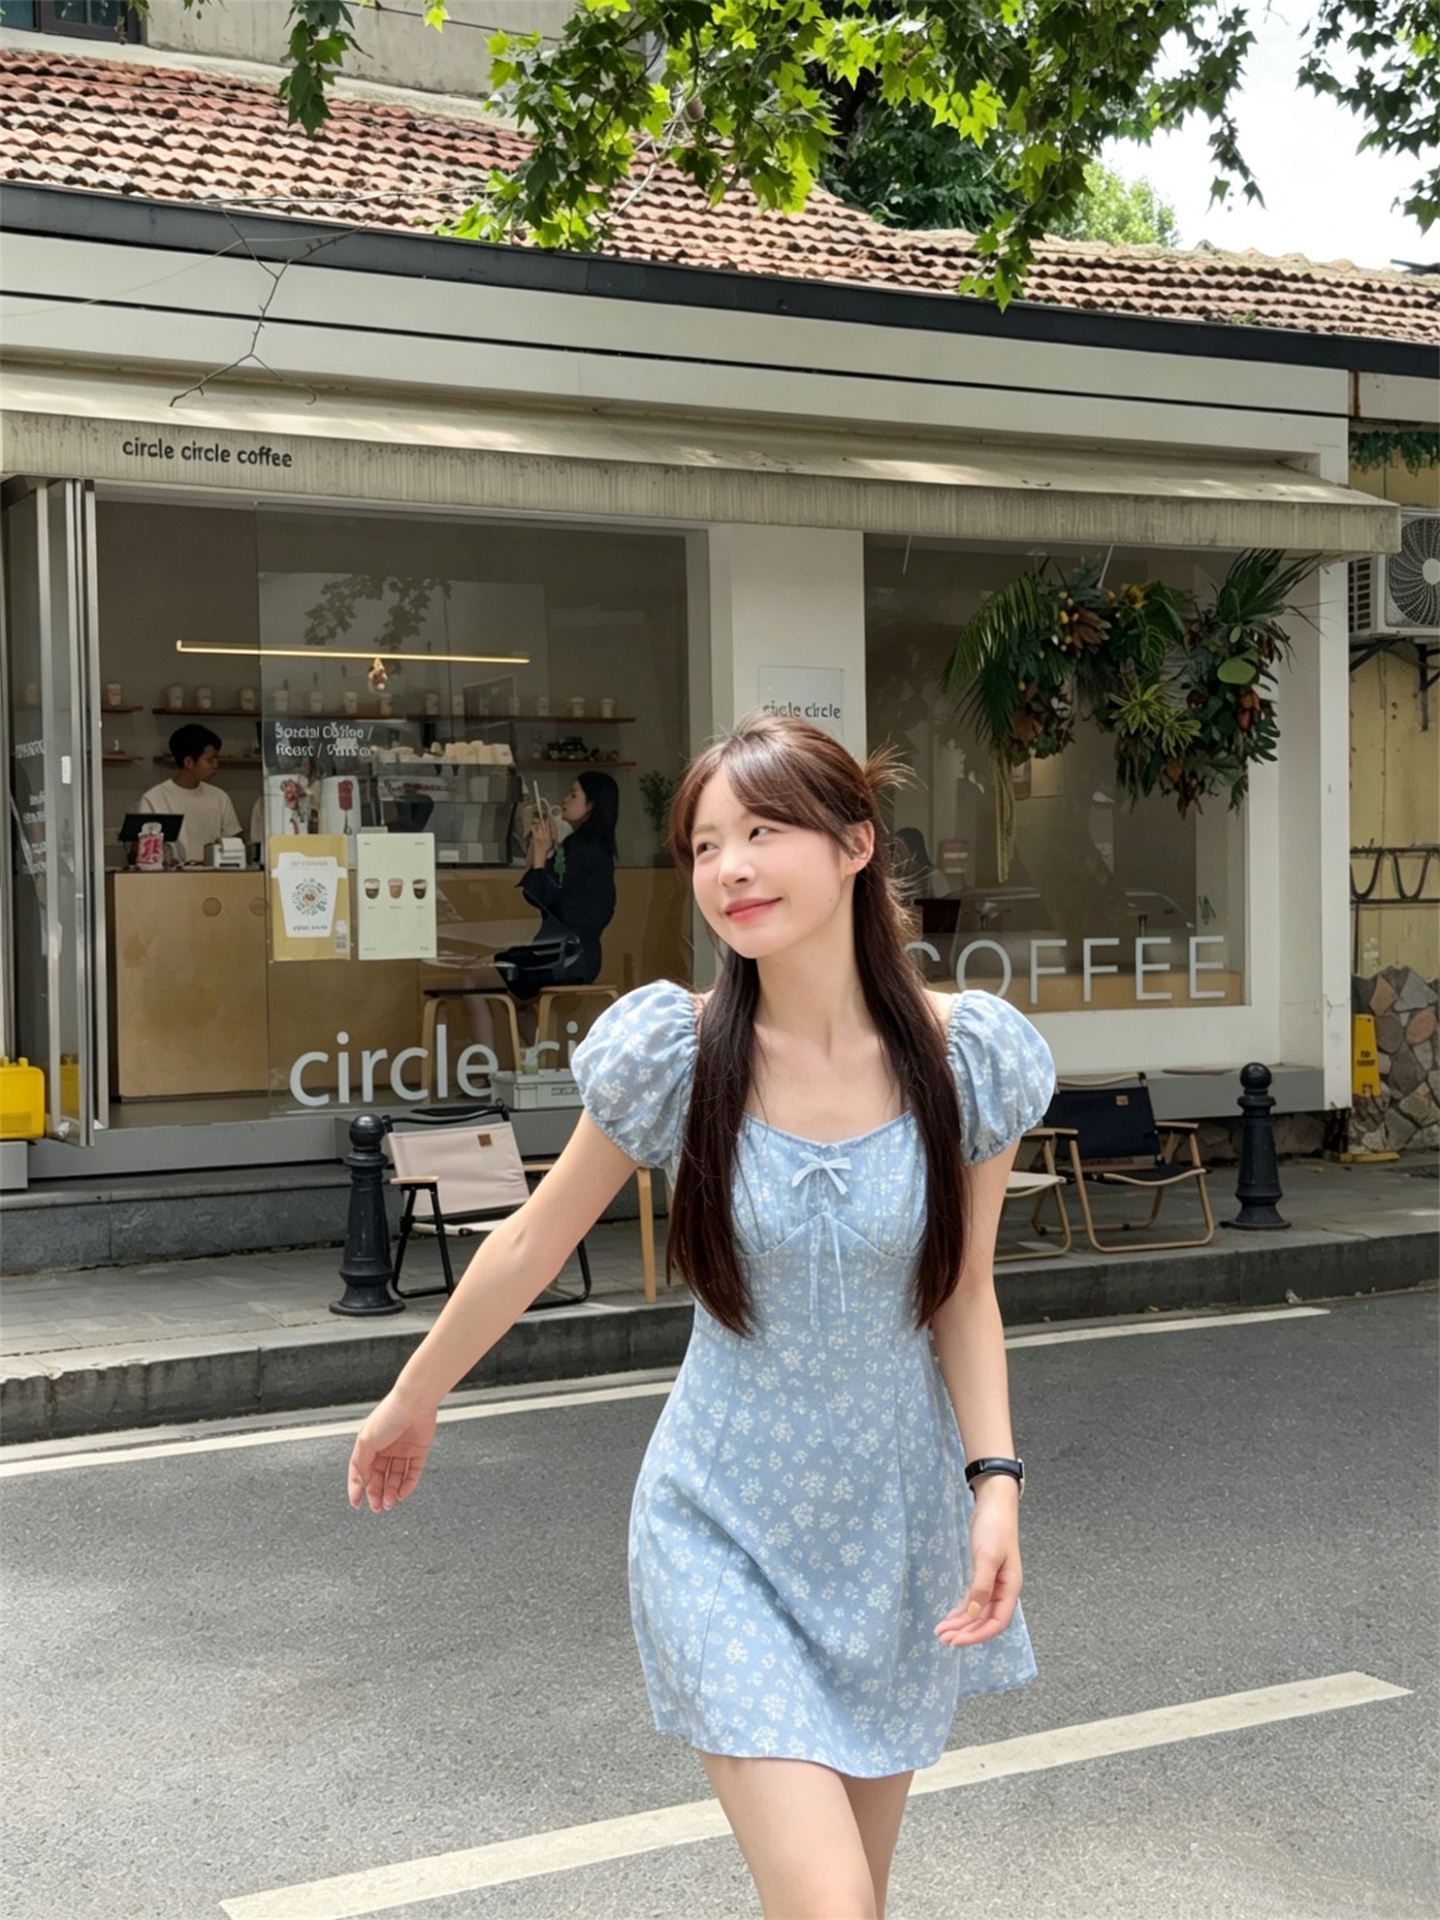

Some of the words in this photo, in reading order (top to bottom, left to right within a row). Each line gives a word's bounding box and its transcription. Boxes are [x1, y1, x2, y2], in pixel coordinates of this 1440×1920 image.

[122, 437, 174, 459] circle
[181, 441, 231, 462] circle
[237, 445, 293, 467] coffee
[805, 702, 841, 719] circle
[289, 1023, 499, 1107] circle
